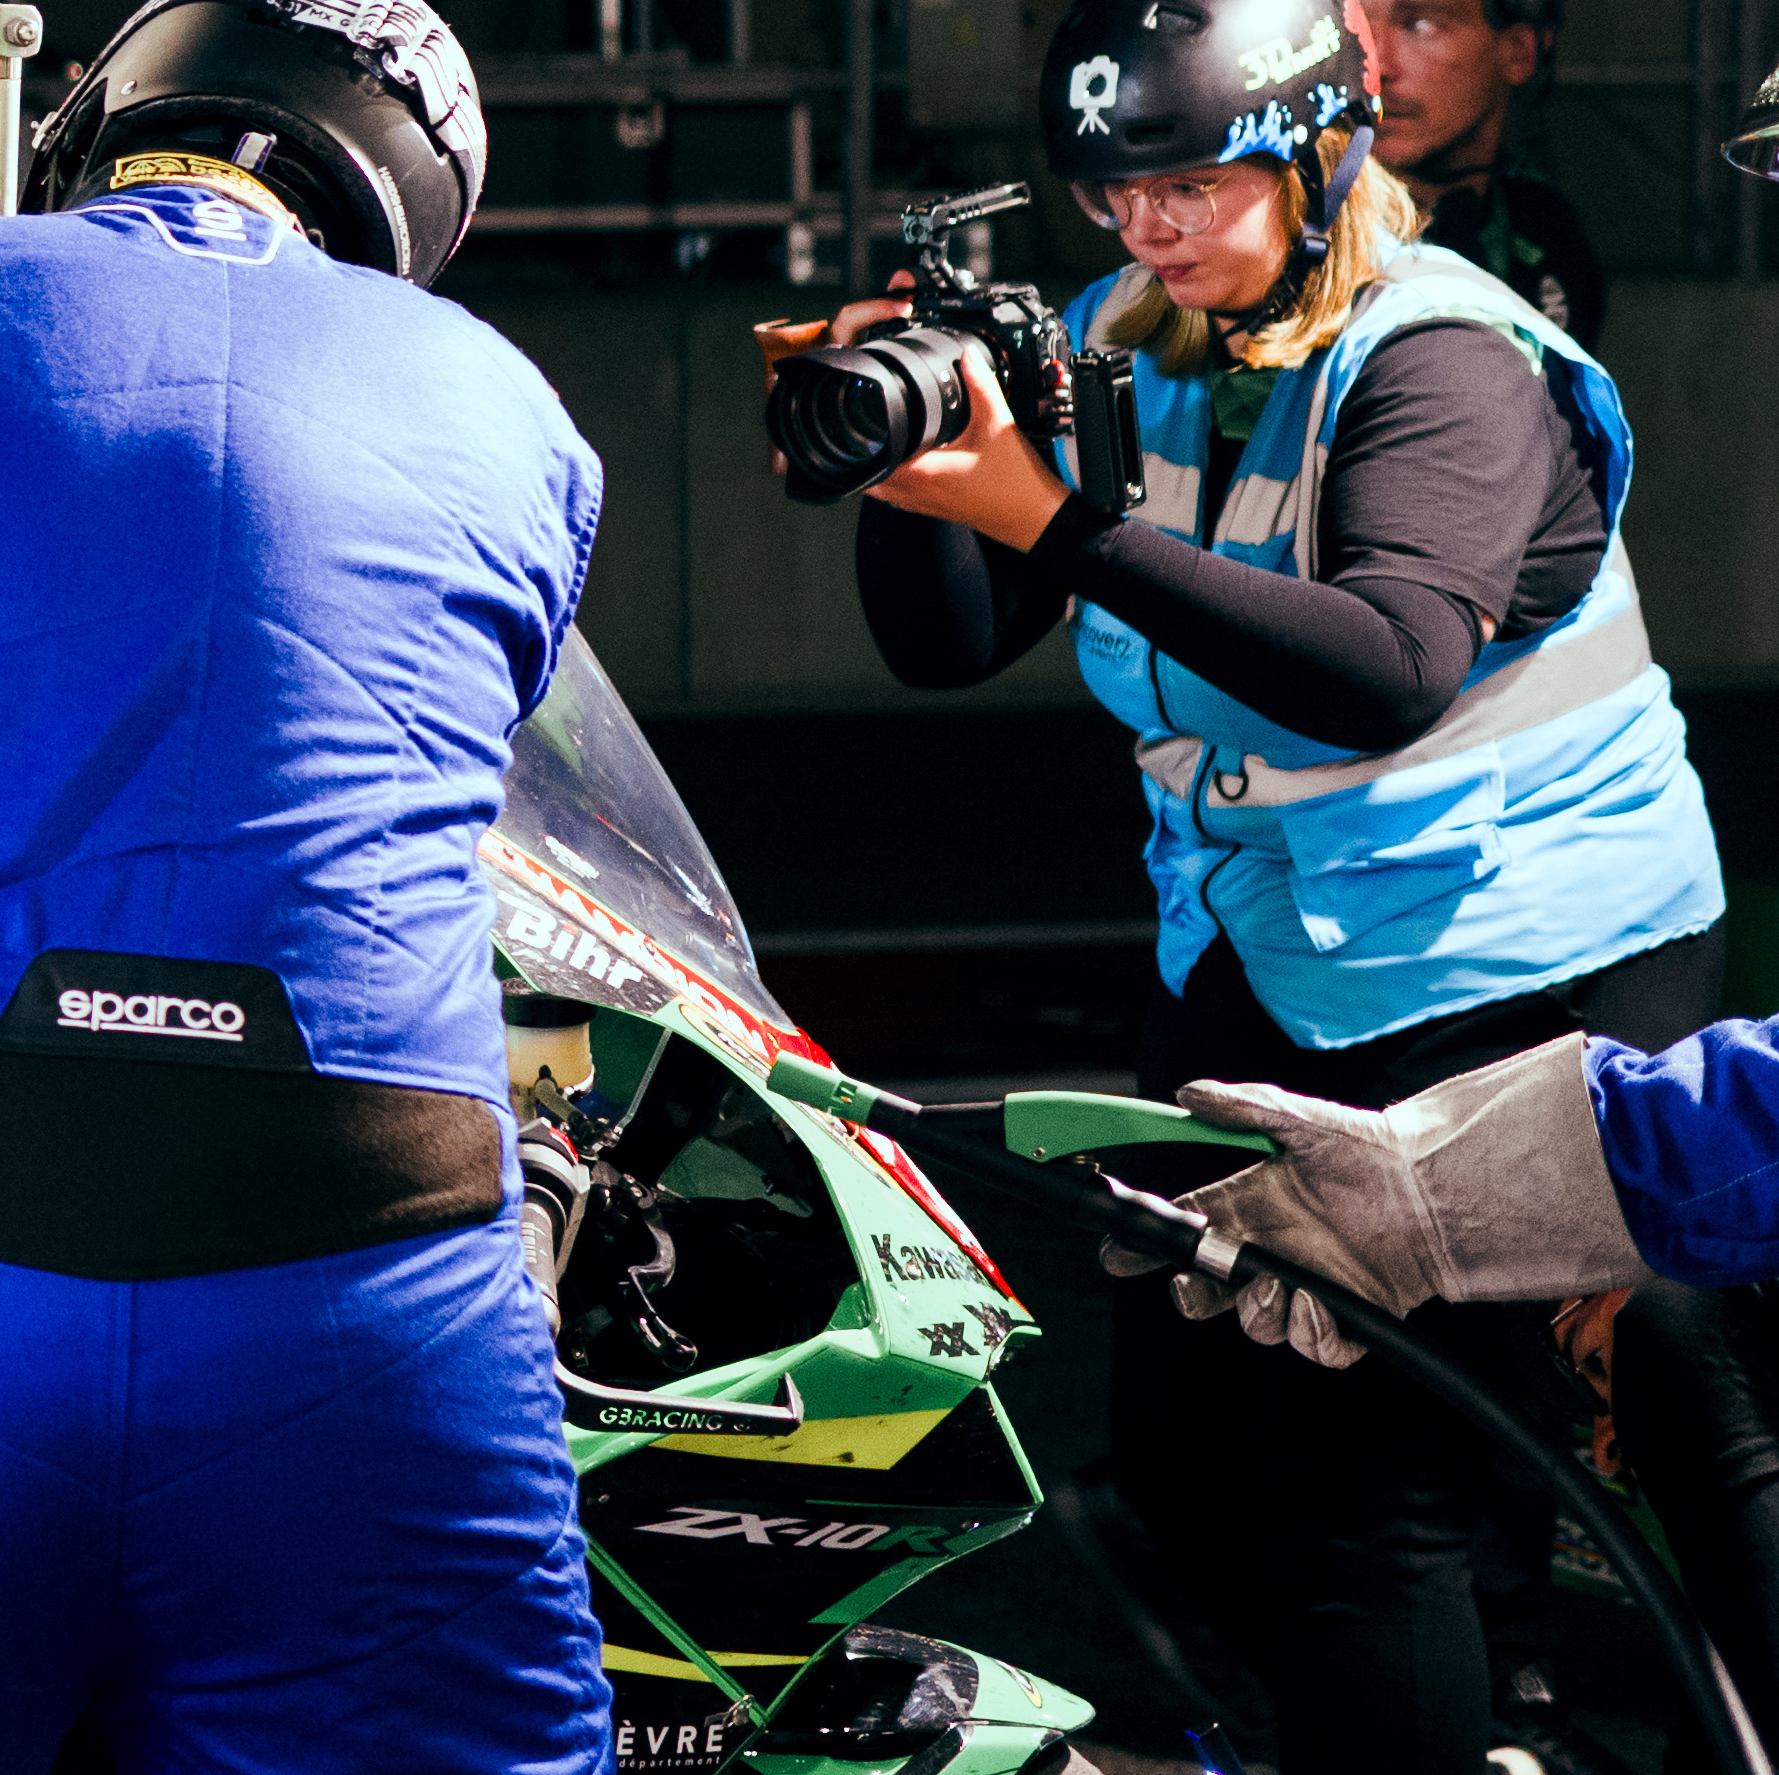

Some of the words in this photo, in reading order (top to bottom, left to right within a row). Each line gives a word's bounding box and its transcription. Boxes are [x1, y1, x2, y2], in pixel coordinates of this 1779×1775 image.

[309, 6, 333, 22] MX
[506, 908, 644, 990] Bihr
[59, 989, 244, 1039] sparco
[616, 1719, 724, 1755] ÈVRE
[618, 1756, 721, 1770] département
